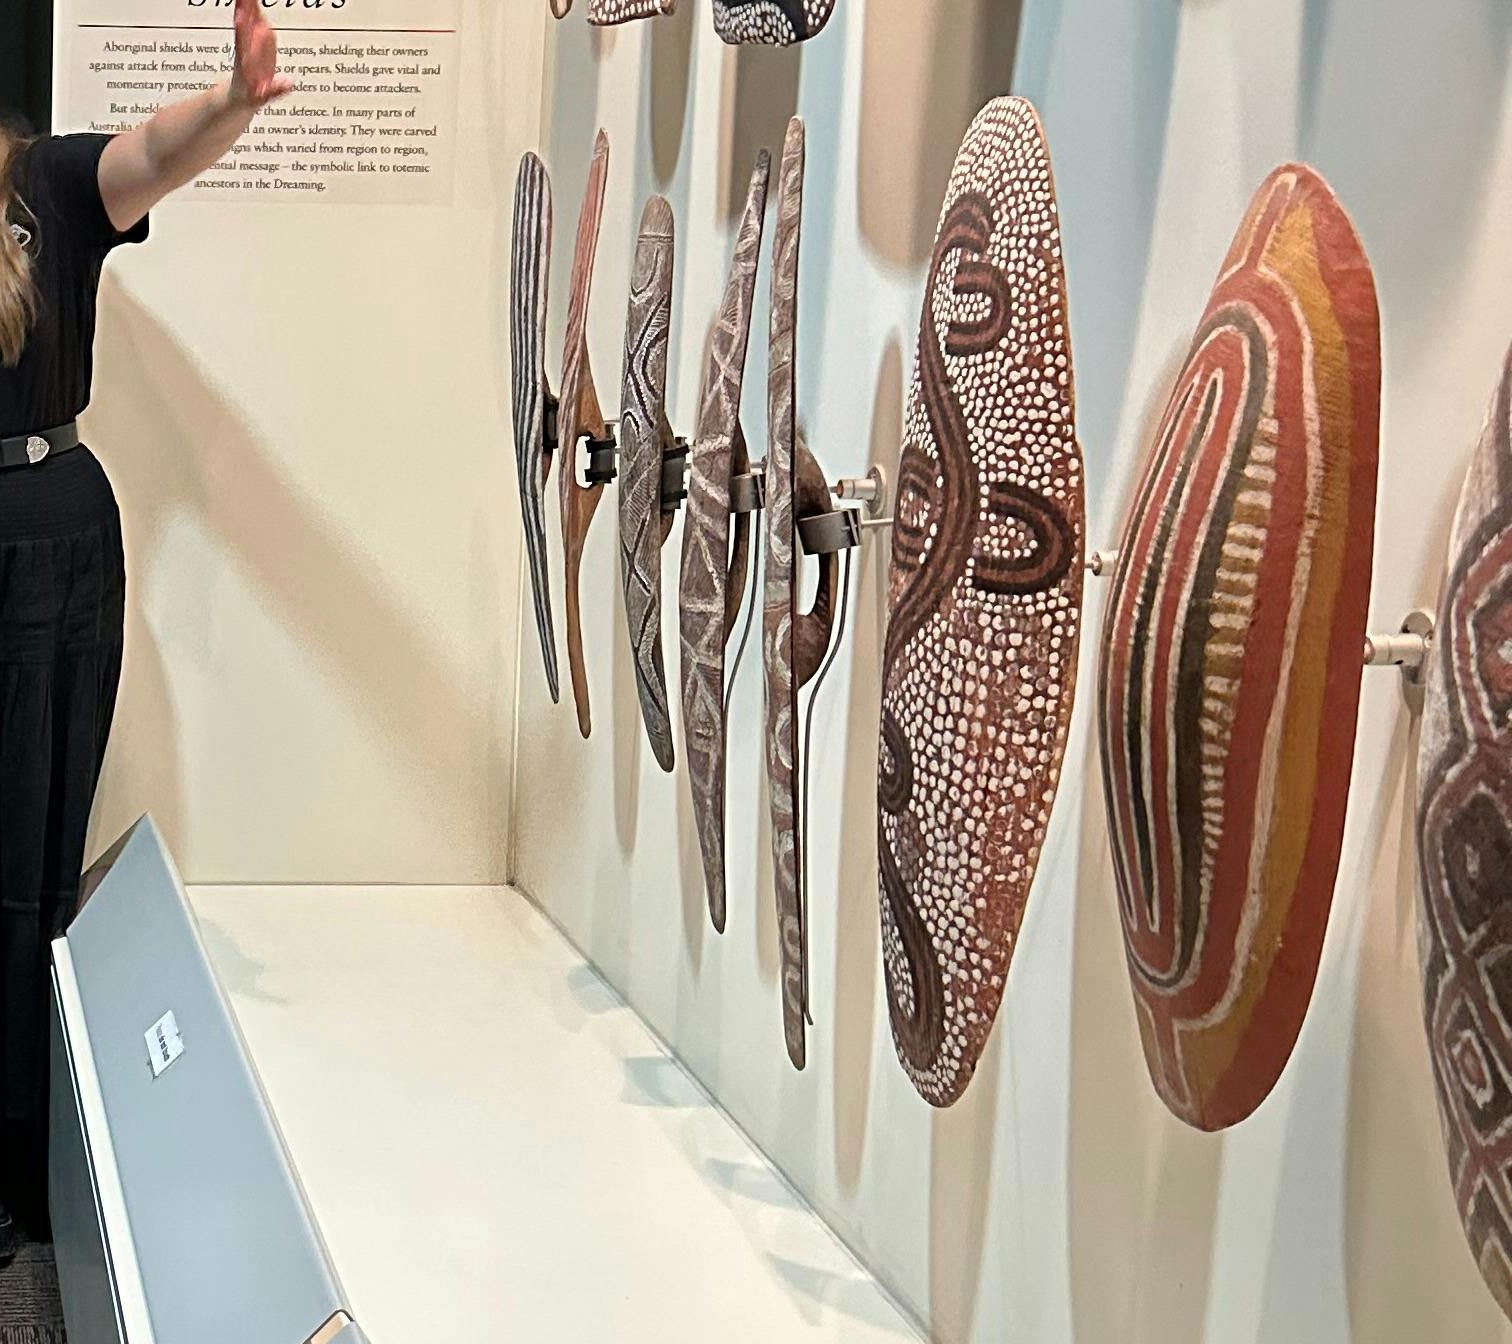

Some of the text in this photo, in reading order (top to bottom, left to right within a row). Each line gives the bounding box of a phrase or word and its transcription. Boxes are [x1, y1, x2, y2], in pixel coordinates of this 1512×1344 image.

[103, 41, 157, 55] Aboriginal
[159, 42, 193, 54] shields
[195, 45, 220, 54] were
[277, 47, 317, 57] eapons,
[318, 44, 364, 58] shielding
[366, 44, 390, 57] their
[392, 47, 428, 57] owners
[88, 62, 125, 72] against
[127, 61, 159, 71] attack
[161, 61, 186, 72] from
[188, 60, 218, 73] clubs,
[283, 65, 296, 74] or
[298, 65, 332, 76] spears.
[335, 63, 370, 75] Shields
[372, 66, 395, 77] gave
[397, 64, 419, 75] vital
[421, 64, 441, 75] and
[106, 79, 164, 92] momentary
[319, 83, 331, 93] to
[333, 81, 373, 93] become
[374, 82, 422, 94] attackers.
[110, 102, 129, 114] But
[130, 102, 160, 114] shield
[263, 105, 287, 116] than
[289, 105, 330, 118] defence.
[332, 106, 344, 117] In
[345, 108, 374, 120] many
[376, 108, 403, 120] parts
[404, 106, 417, 118] of
[88, 120, 133, 132] Australia
[252, 126, 265, 135] an
[308, 124, 347, 137] identity.
[350, 124, 377, 138] They
[379, 126, 402, 136] were
[404, 125, 437, 137] carved
[254, 141, 284, 153] which
[286, 142, 317, 154] varied
[318, 142, 344, 155] from
[346, 145, 378, 157] region
[380, 146, 392, 155] to
[393, 145, 429, 157] region,
[239, 162, 281, 174] message
[291, 161, 307, 172] the
[309, 161, 355, 174] symbolic
[357, 162, 376, 173] link
[379, 164, 391, 173] to
[392, 163, 430, 174] totemic
[194, 177, 327, 192] ancestors in the Dreaming.
